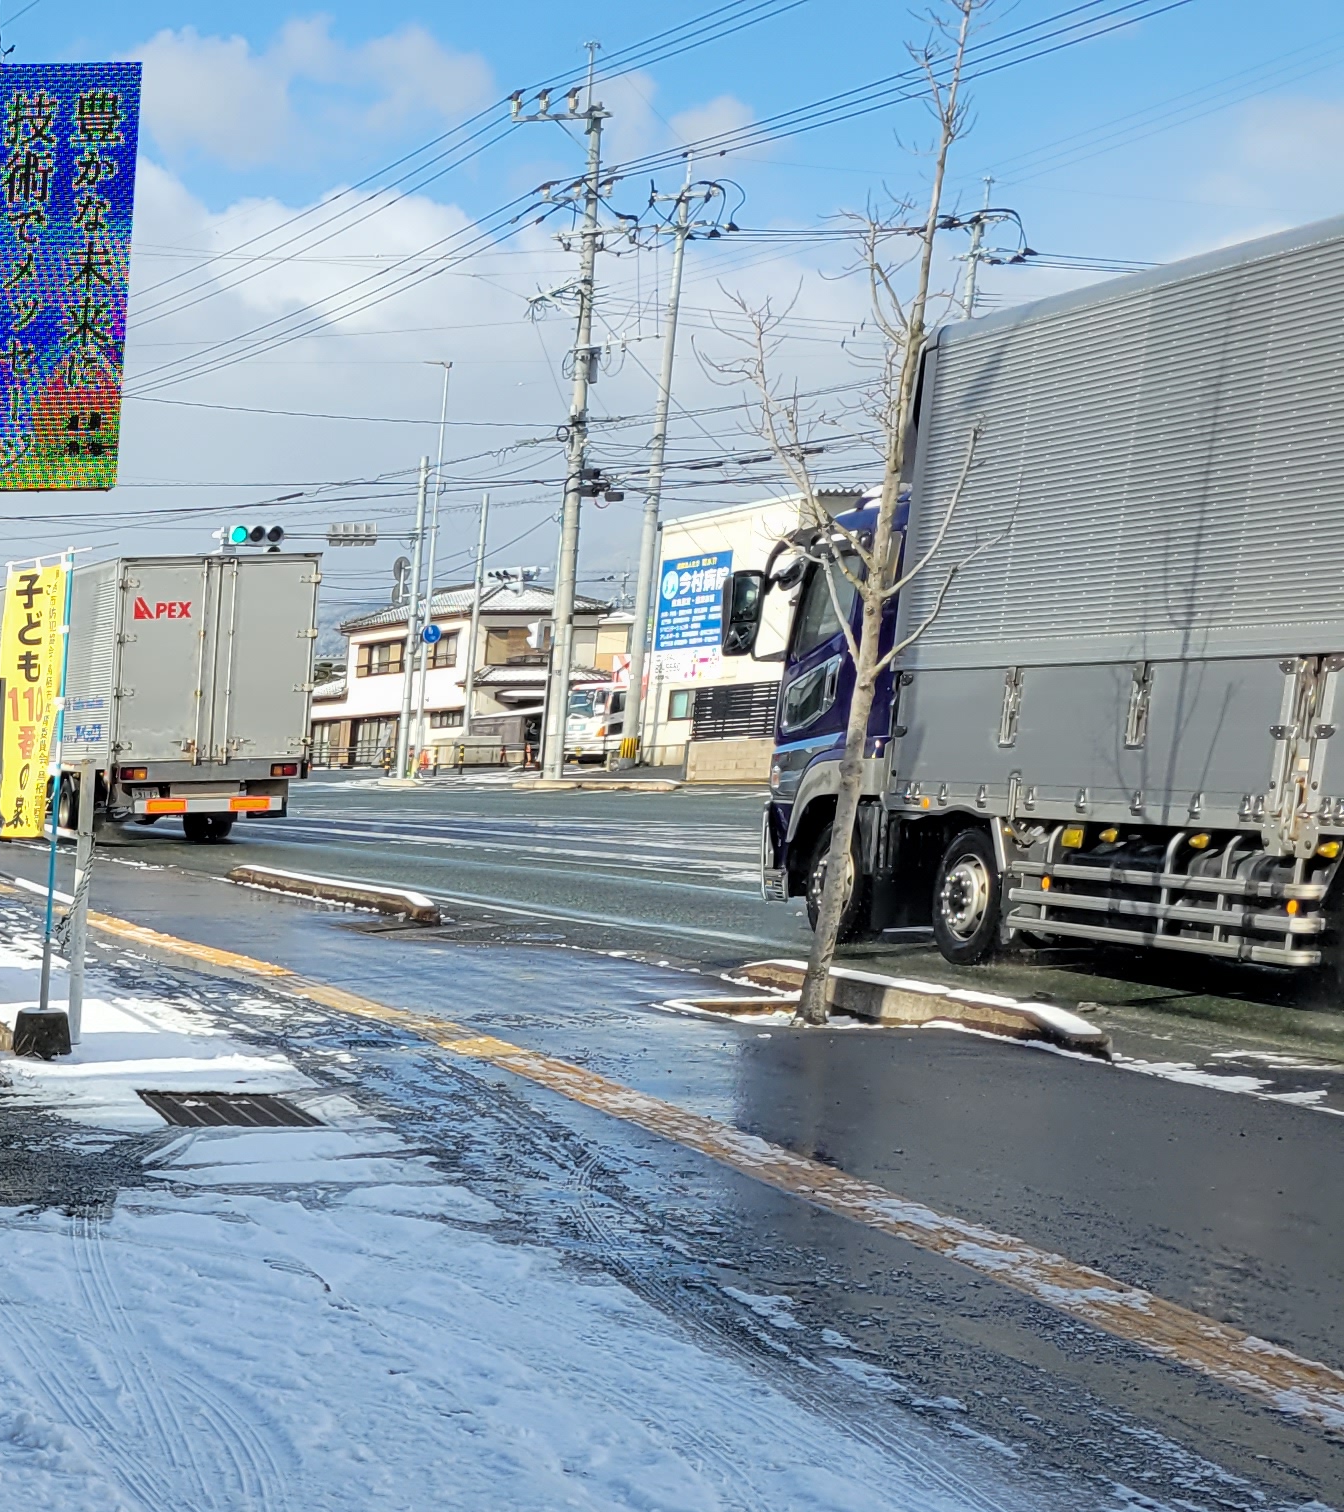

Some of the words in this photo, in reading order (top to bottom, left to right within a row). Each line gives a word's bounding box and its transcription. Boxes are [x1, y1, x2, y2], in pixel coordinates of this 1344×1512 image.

[0, 92, 56, 469] 技術でメッセージ
[66, 93, 123, 386] 豊かな未来に
[133, 597, 192, 620] APEX
